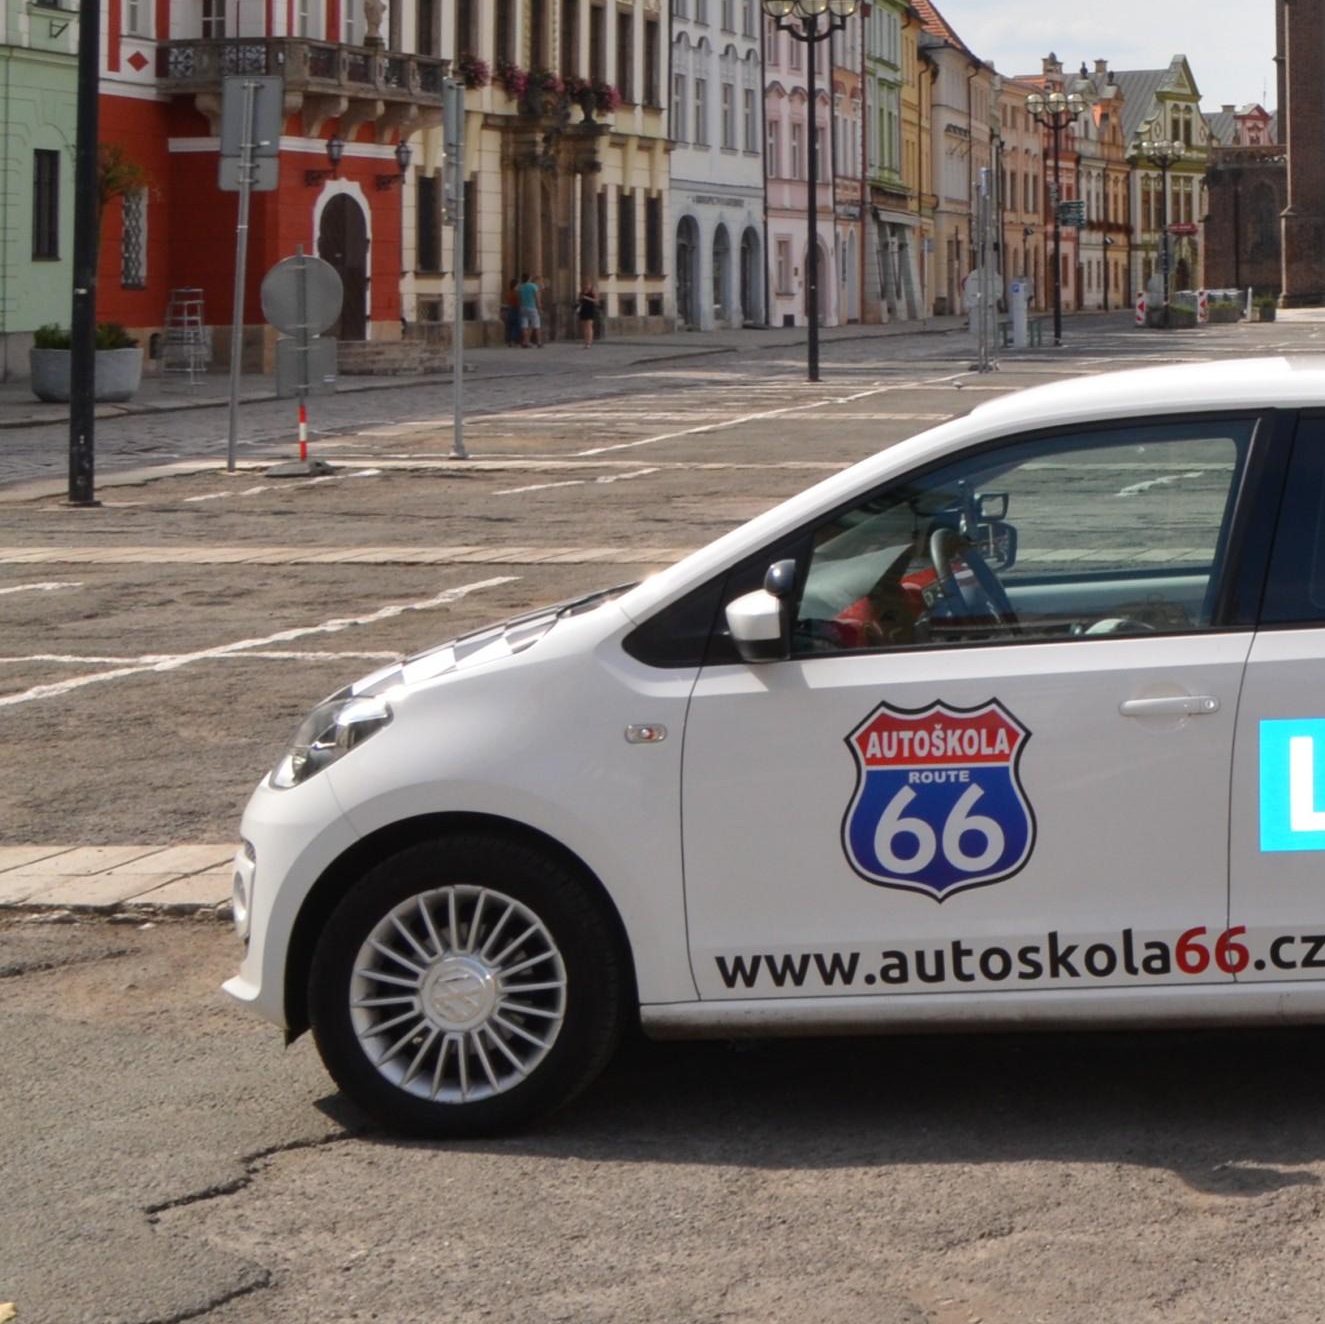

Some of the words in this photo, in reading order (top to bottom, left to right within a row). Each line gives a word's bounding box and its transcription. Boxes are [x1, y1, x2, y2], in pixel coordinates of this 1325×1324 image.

[866, 723, 1010, 759] AUTOŠKOLA
[908, 769, 970, 785] ROUTE
[873, 783, 1005, 874] 66
